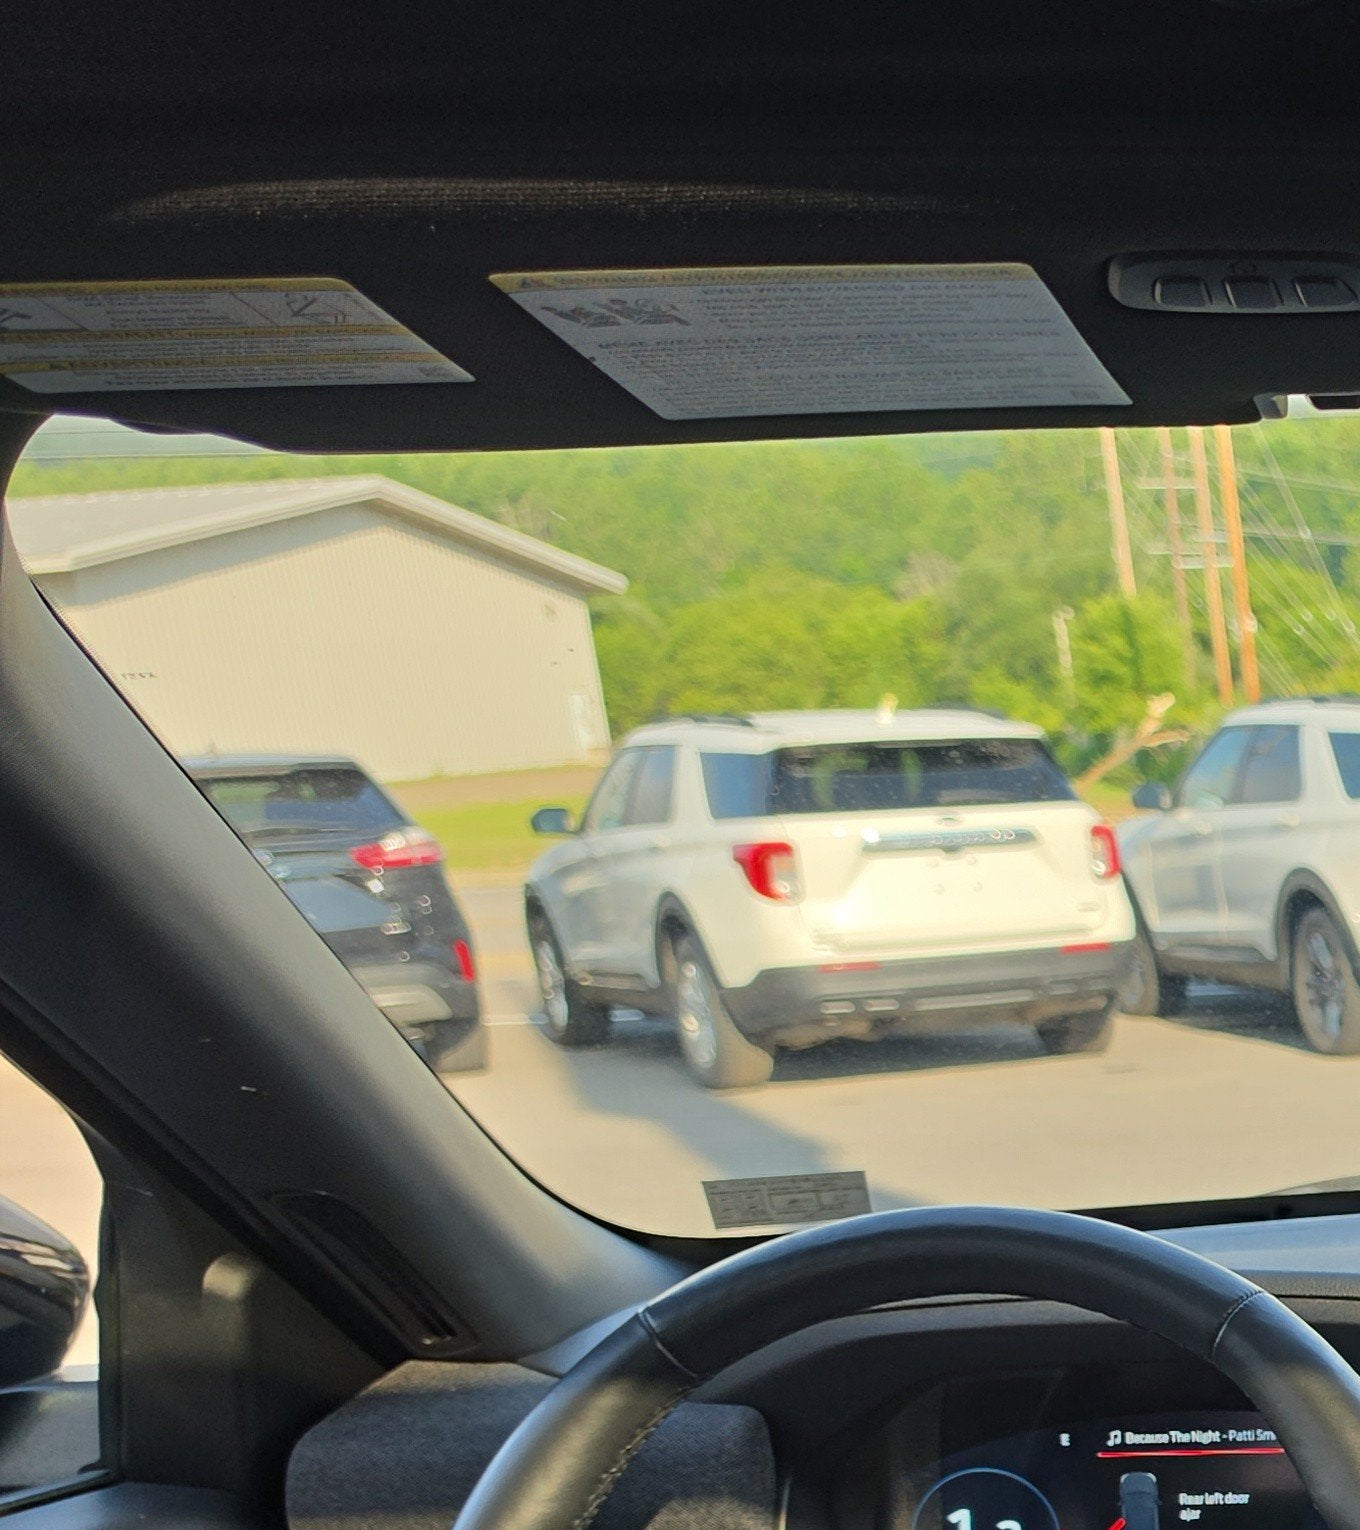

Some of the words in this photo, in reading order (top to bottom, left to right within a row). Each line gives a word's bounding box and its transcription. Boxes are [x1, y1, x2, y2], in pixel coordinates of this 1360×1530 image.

[1124, 1431, 1169, 1445] Because
[1169, 1430, 1192, 1443] The
[1191, 1429, 1222, 1445] Night
[1228, 1429, 1255, 1443] Patti
